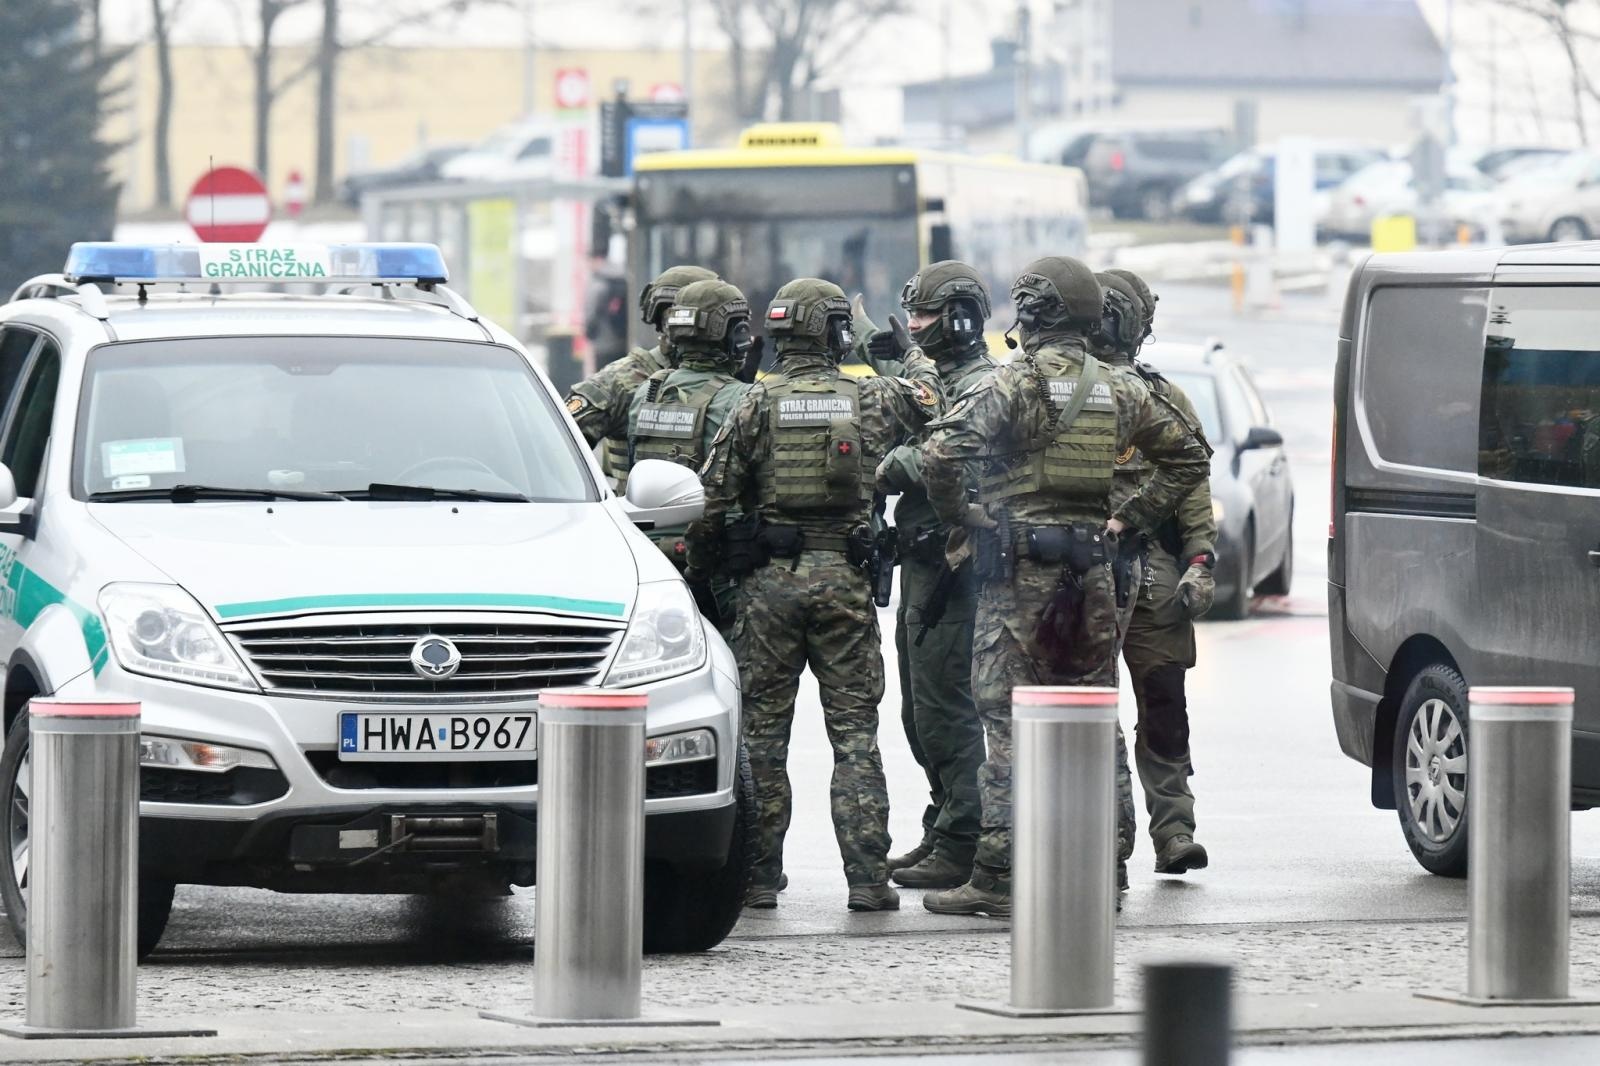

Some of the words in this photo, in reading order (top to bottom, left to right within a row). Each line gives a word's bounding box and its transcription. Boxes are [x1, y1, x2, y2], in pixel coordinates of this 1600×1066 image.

[205, 262, 326, 277] GRANICZNA
[806, 399, 852, 412] GRANICZNA
[364, 717, 437, 750] HWA
[450, 716, 532, 750] B967
[343, 739, 356, 748] PL
